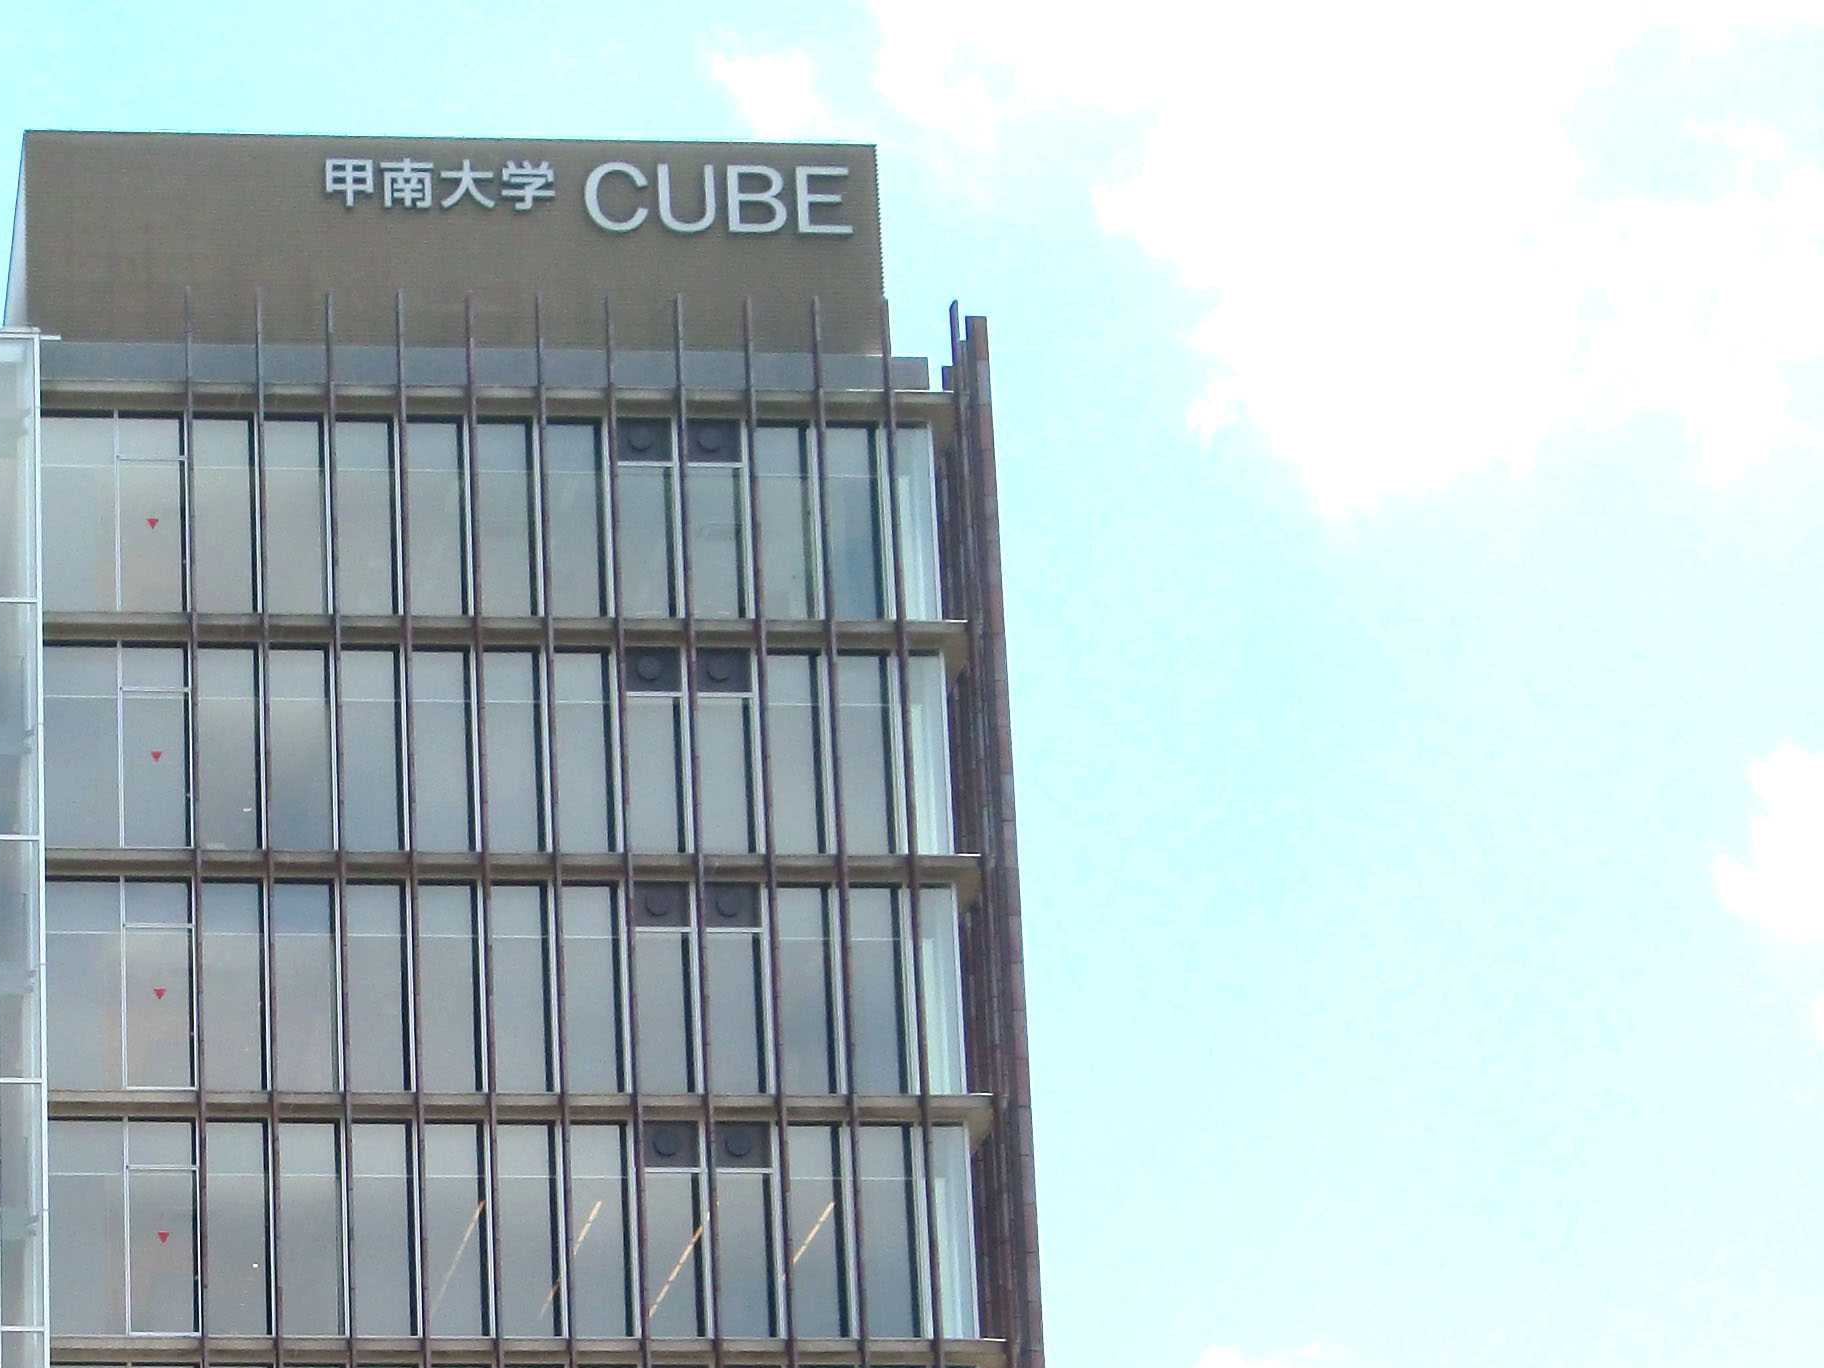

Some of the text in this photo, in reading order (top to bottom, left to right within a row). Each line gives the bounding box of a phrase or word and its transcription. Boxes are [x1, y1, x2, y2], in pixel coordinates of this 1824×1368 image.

[324, 157, 853, 235] 甲南大学 CUBE
